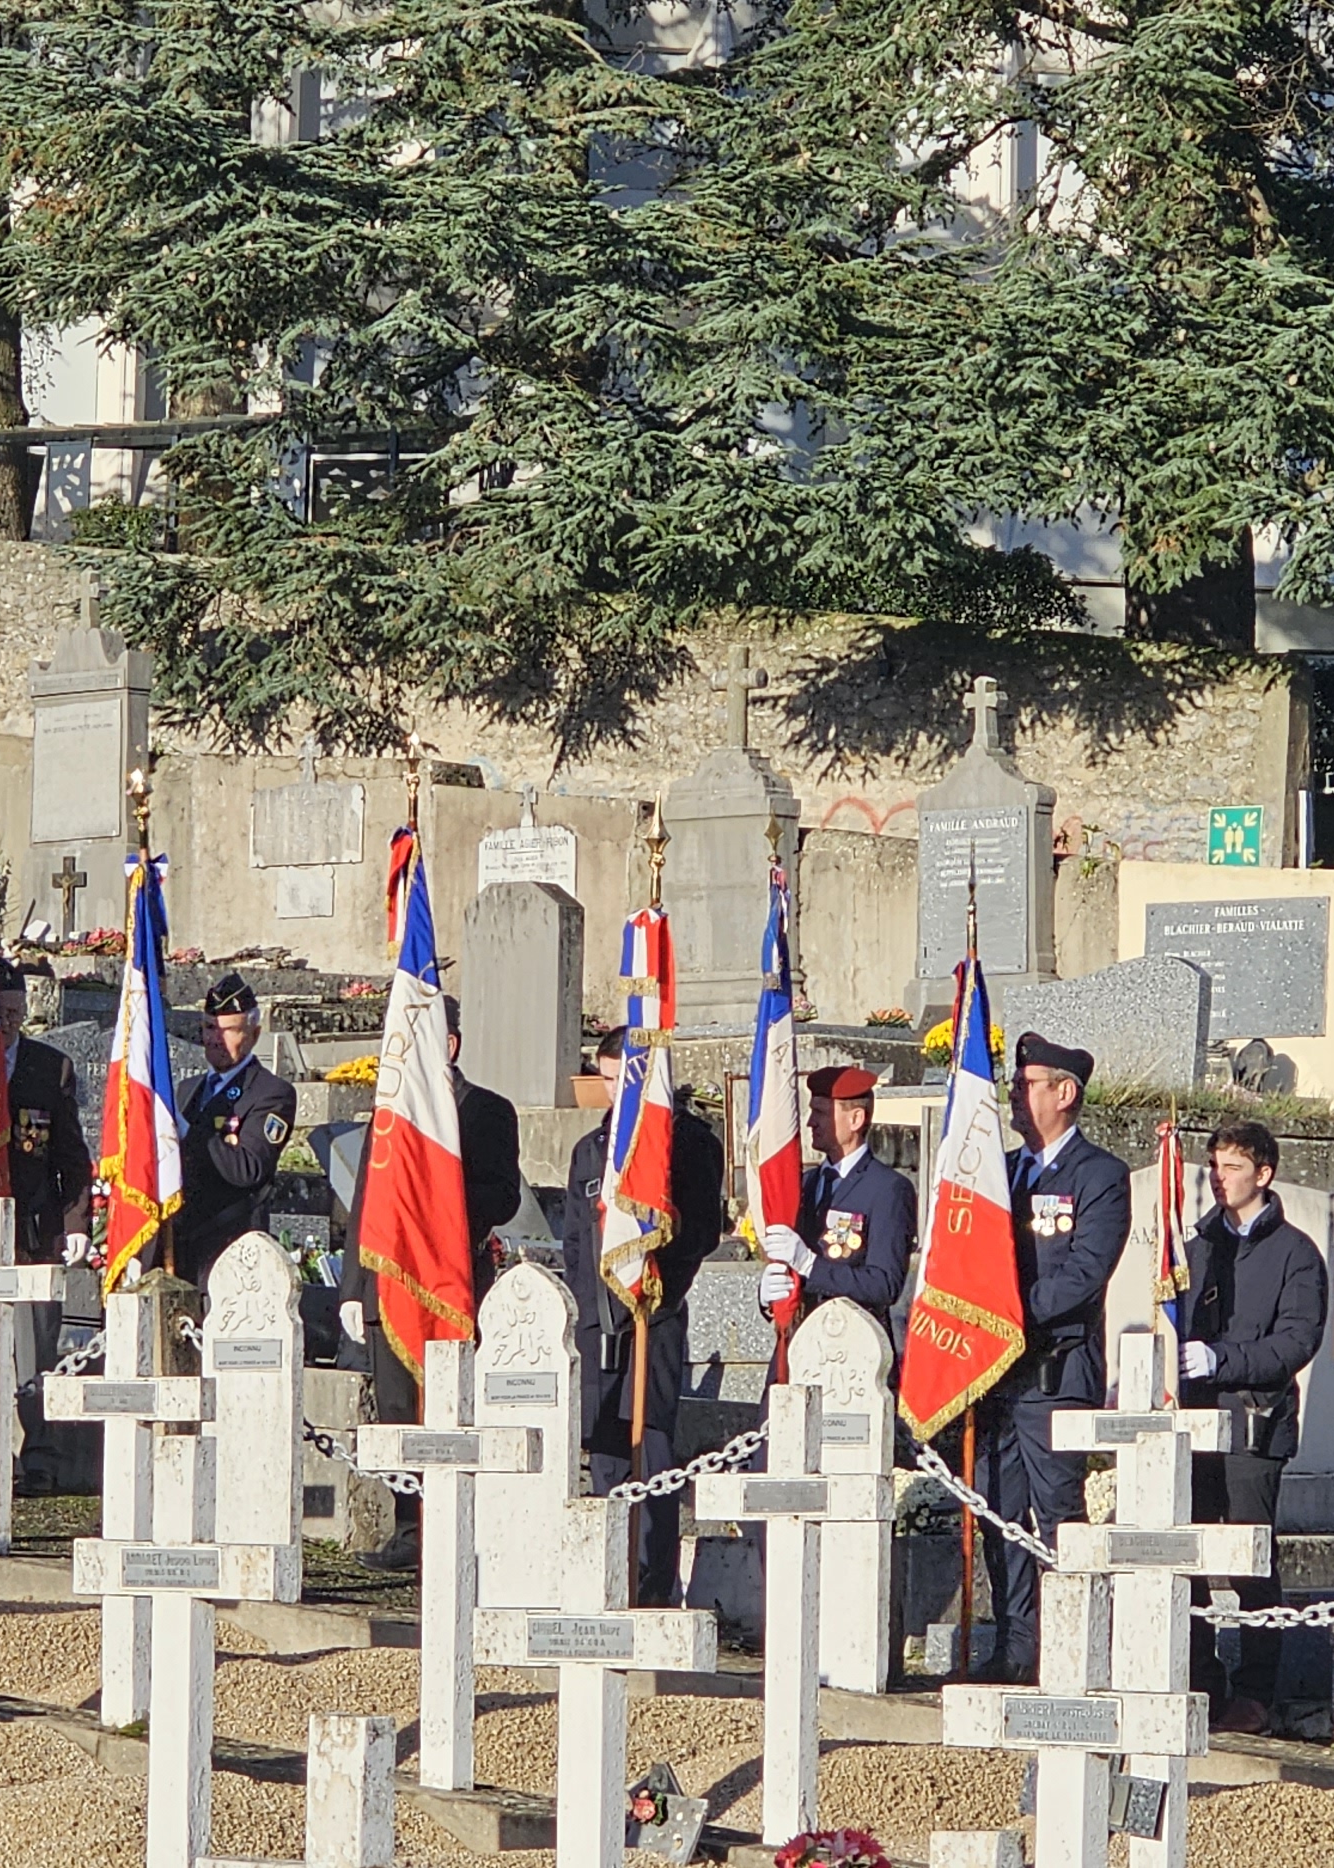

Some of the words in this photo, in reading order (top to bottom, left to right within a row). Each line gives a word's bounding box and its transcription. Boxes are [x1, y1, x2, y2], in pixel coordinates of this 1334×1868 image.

[929, 819, 967, 833] FAMILLE
[971, 817, 1018, 830] ANDRAUD
[484, 840, 516, 851] FAMILLE
[1214, 904, 1259, 918] FAMILLES
[821, 1419, 847, 1427] CONNU
